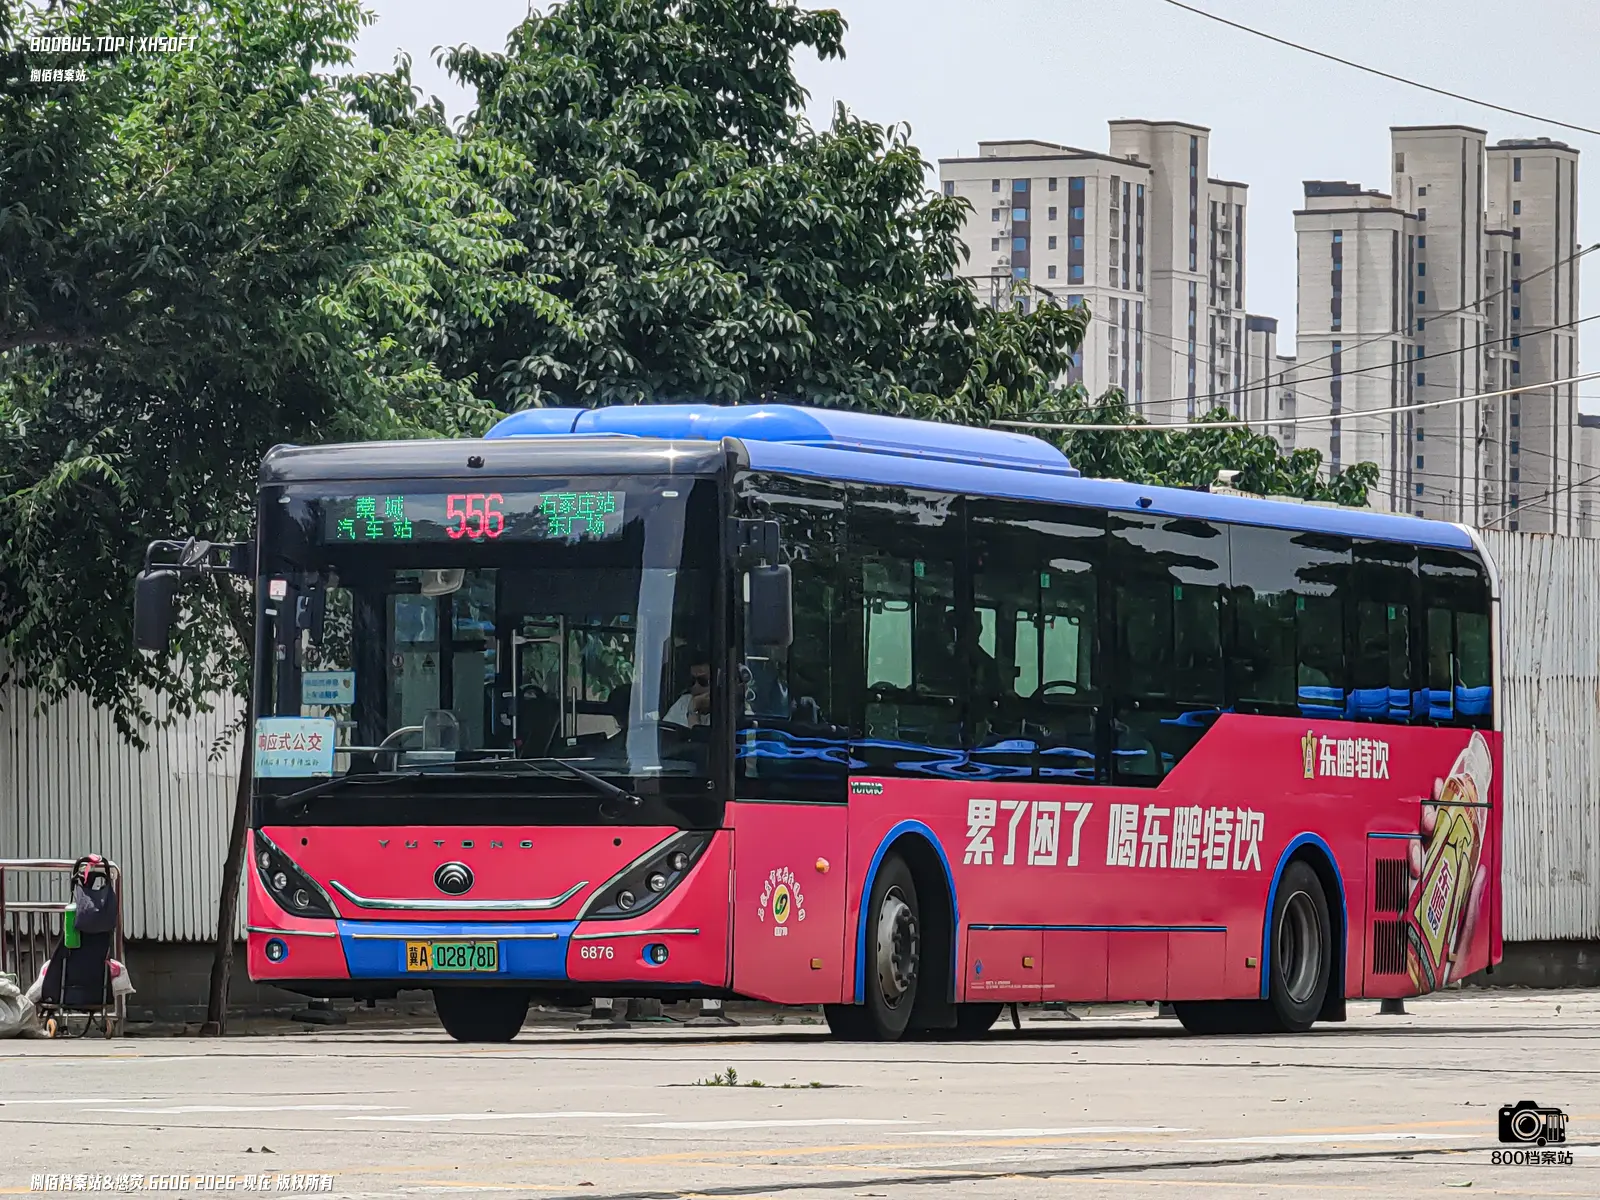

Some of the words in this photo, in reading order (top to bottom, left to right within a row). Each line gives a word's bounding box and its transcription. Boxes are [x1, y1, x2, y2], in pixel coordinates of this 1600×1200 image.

[539, 491, 615, 514] 石家庄站
[446, 493, 504, 539] 556
[547, 513, 605, 535] 东广场
[337, 517, 412, 539] 汽车站
[1319, 734, 1390, 779] 东鹏特饮
[378, 839, 534, 849] YUTONG
[962, 798, 1094, 866] 累了困了
[1105, 803, 1265, 872] 喝东鹏特饮
[580, 946, 614, 960] 6876
